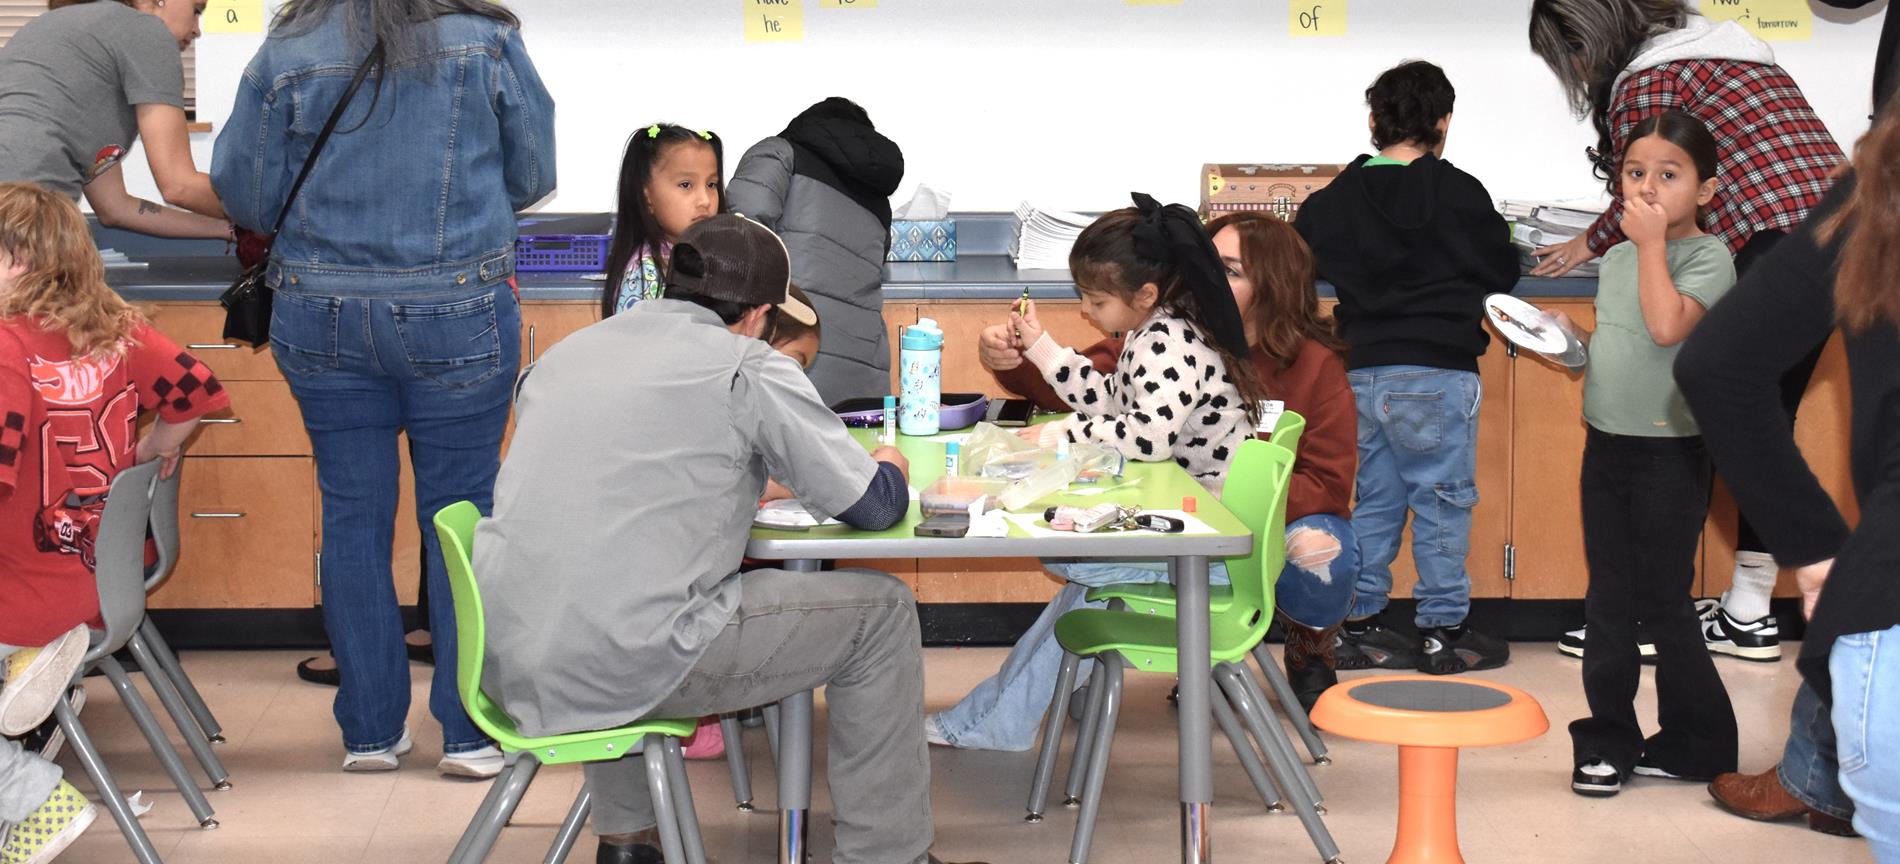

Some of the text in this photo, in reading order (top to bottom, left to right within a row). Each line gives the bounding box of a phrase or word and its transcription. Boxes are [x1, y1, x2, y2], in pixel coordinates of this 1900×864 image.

[226, 9, 238, 23] a
[763, 14, 781, 32] he
[1299, 6, 1321, 30] of
[1757, 17, 1798, 28] tomorrow
